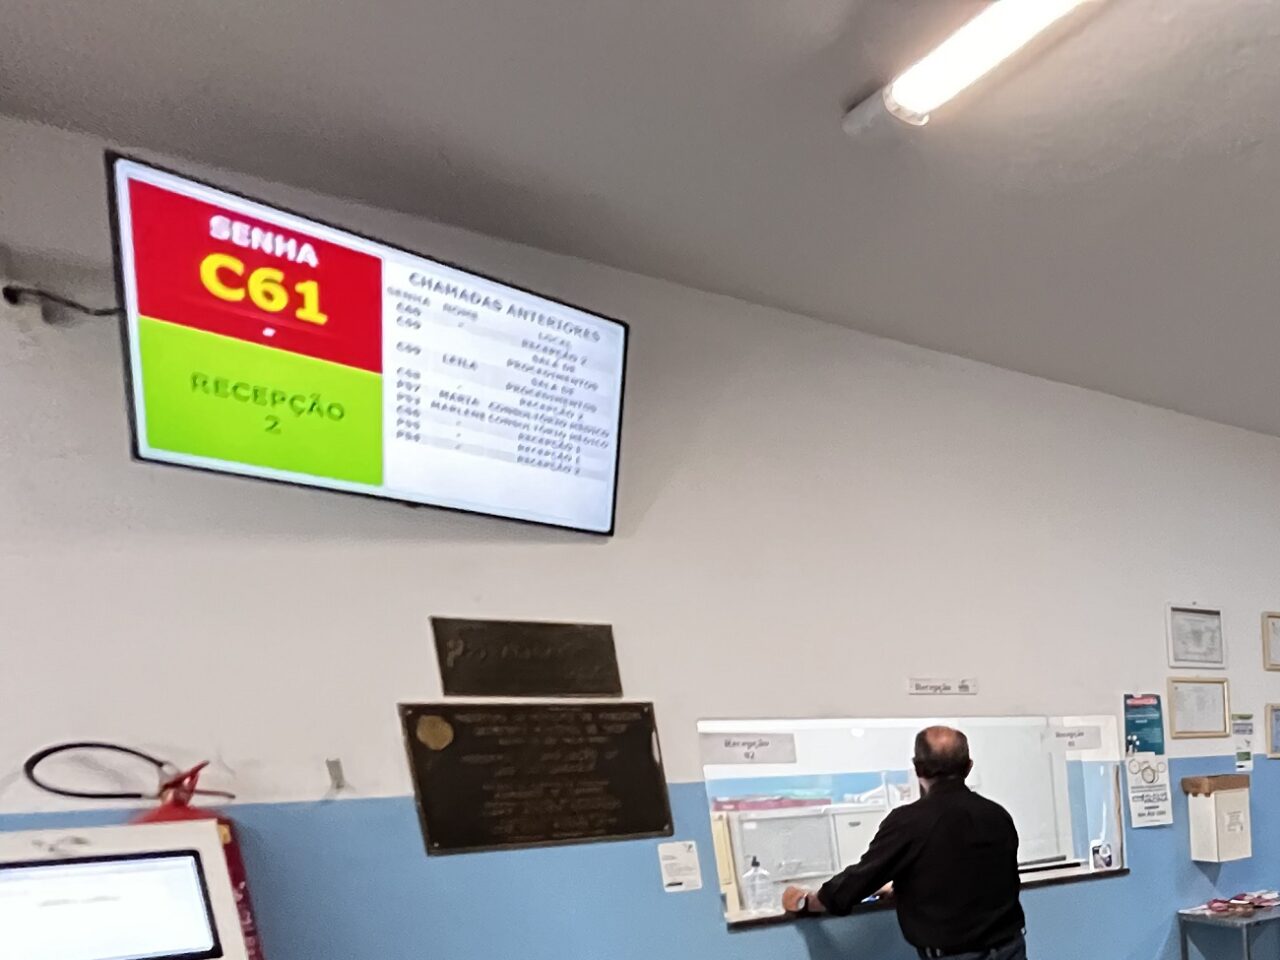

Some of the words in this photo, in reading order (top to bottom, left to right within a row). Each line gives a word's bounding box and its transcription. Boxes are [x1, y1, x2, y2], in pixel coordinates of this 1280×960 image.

[209, 214, 319, 268] SENHA
[199, 253, 328, 325] C61
[408, 271, 503, 312] CHAMADAS
[506, 303, 601, 343] ANTERIORES
[190, 371, 345, 421] RECEPÇÃO
[264, 414, 282, 435] 2
